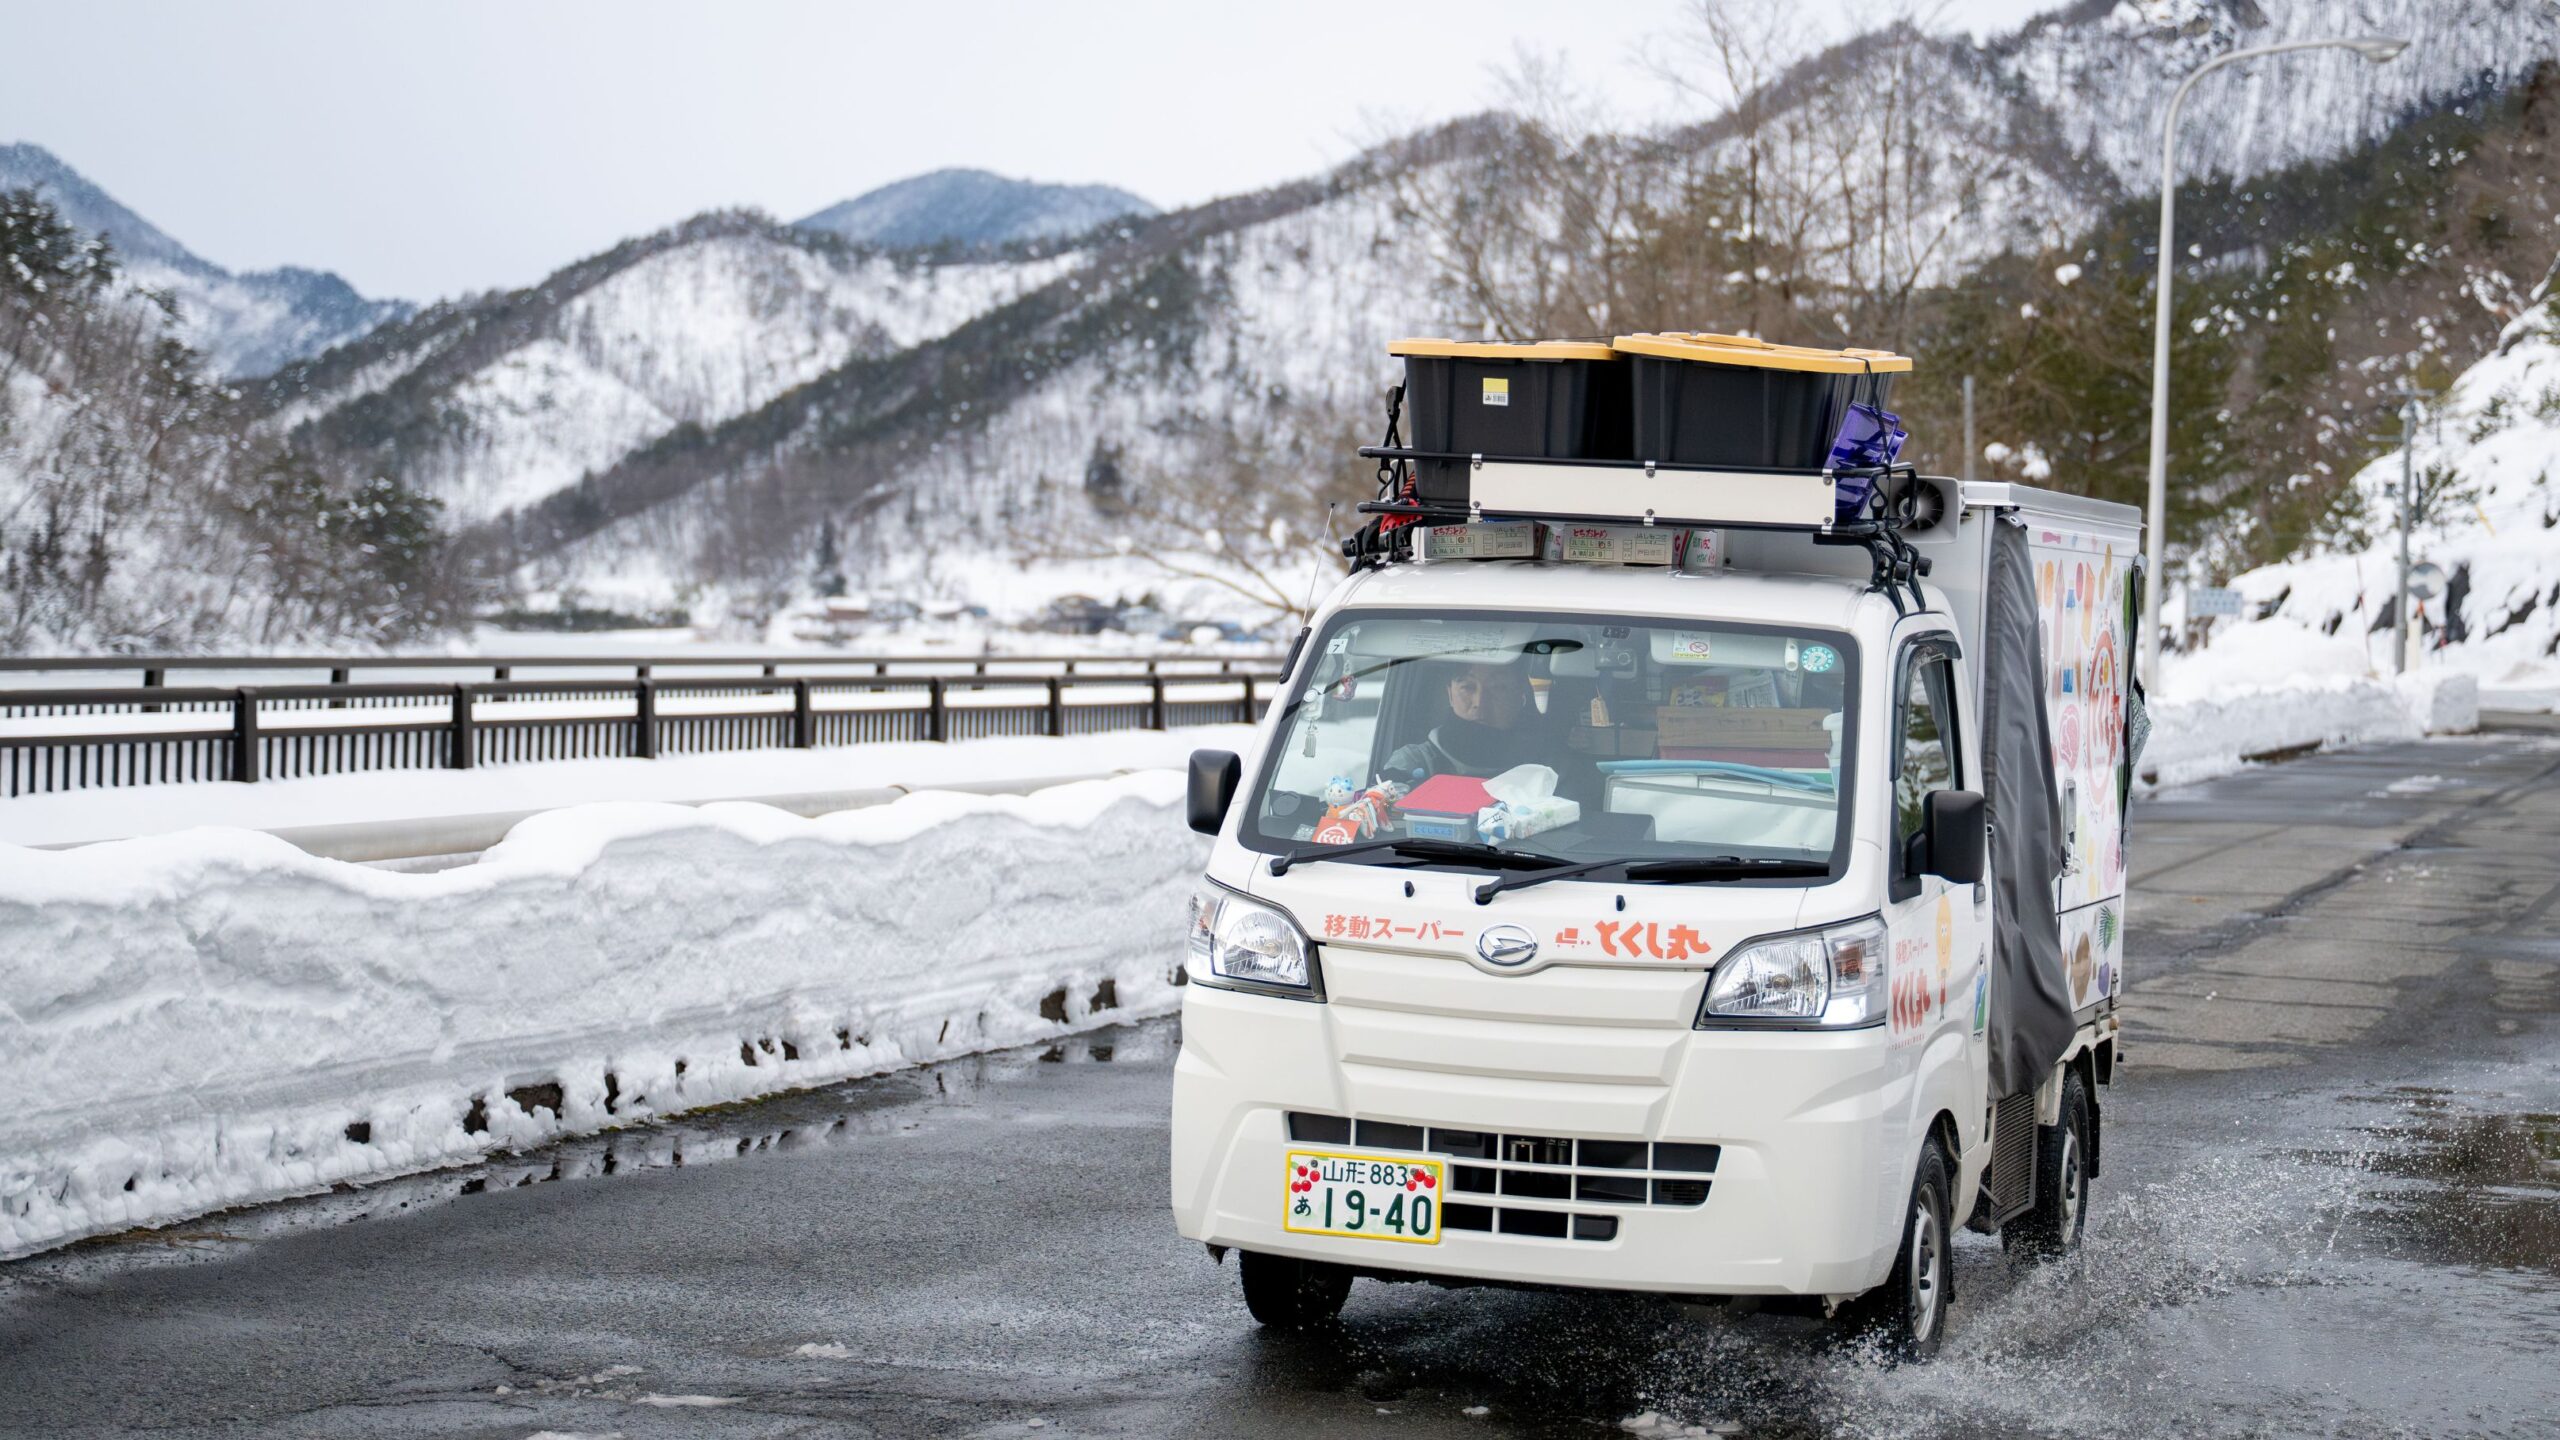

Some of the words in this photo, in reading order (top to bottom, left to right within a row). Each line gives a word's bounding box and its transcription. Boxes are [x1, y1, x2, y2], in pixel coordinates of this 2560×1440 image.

[1324, 914, 1464, 939] 移動スーパー
[1594, 919, 1712, 960] とくし丸
[1323, 1160, 1365, 1184] 山形
[1370, 1163, 1408, 1187] 883
[1294, 1196, 1311, 1216] あ
[1325, 1187, 1432, 1236] 19-40
